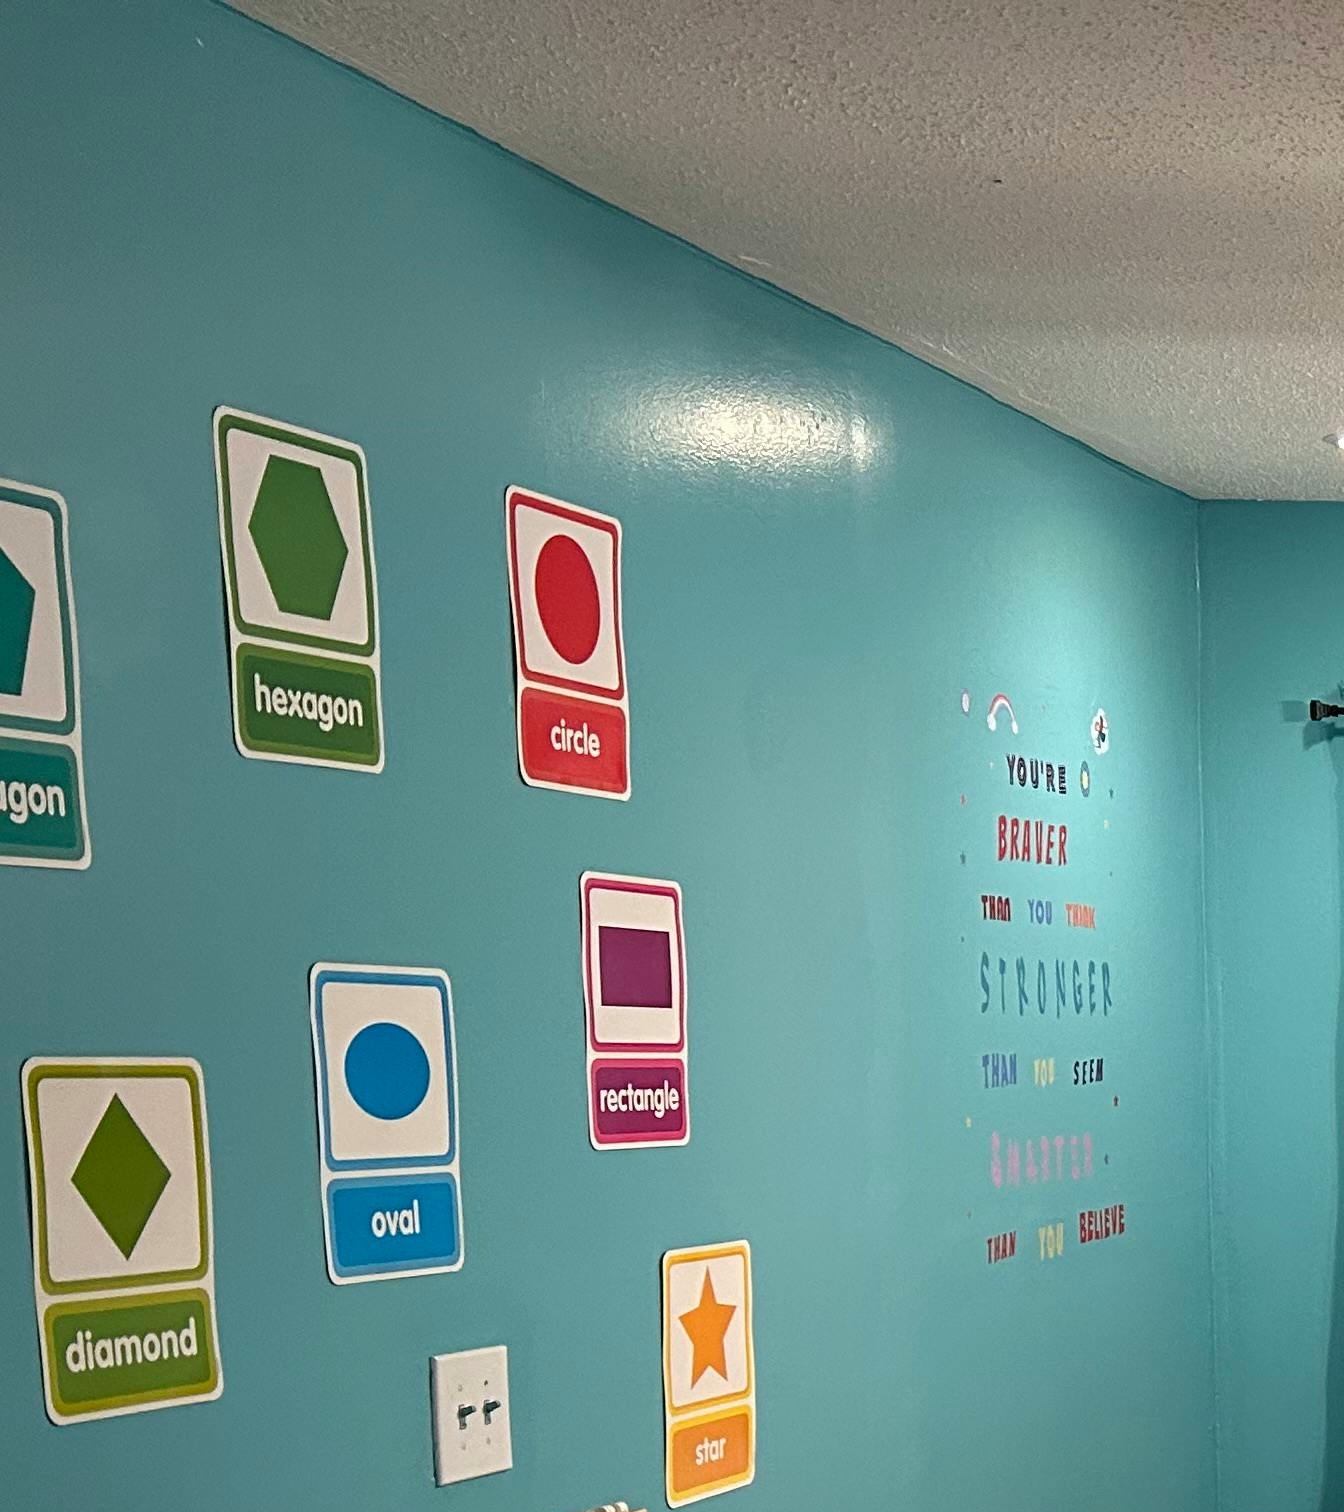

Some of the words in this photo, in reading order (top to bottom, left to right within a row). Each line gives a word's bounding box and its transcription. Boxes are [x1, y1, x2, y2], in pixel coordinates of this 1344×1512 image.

[254, 672, 363, 732] hexagon
[551, 720, 601, 758] circle
[1006, 753, 1067, 795] YOU'RE
[998, 815, 1067, 866] BRAVER
[1027, 899, 1053, 925] YOU
[980, 951, 1112, 1019] STRONGER
[982, 1053, 1017, 1089] THAN
[600, 1079, 679, 1119] rectangle
[371, 1200, 420, 1238] oval
[987, 1231, 1016, 1264] THAN
[1038, 1222, 1064, 1261] YOU
[1079, 1204, 1125, 1243] BELIEVE
[65, 1318, 198, 1373] diamond
[695, 1435, 727, 1465] star
